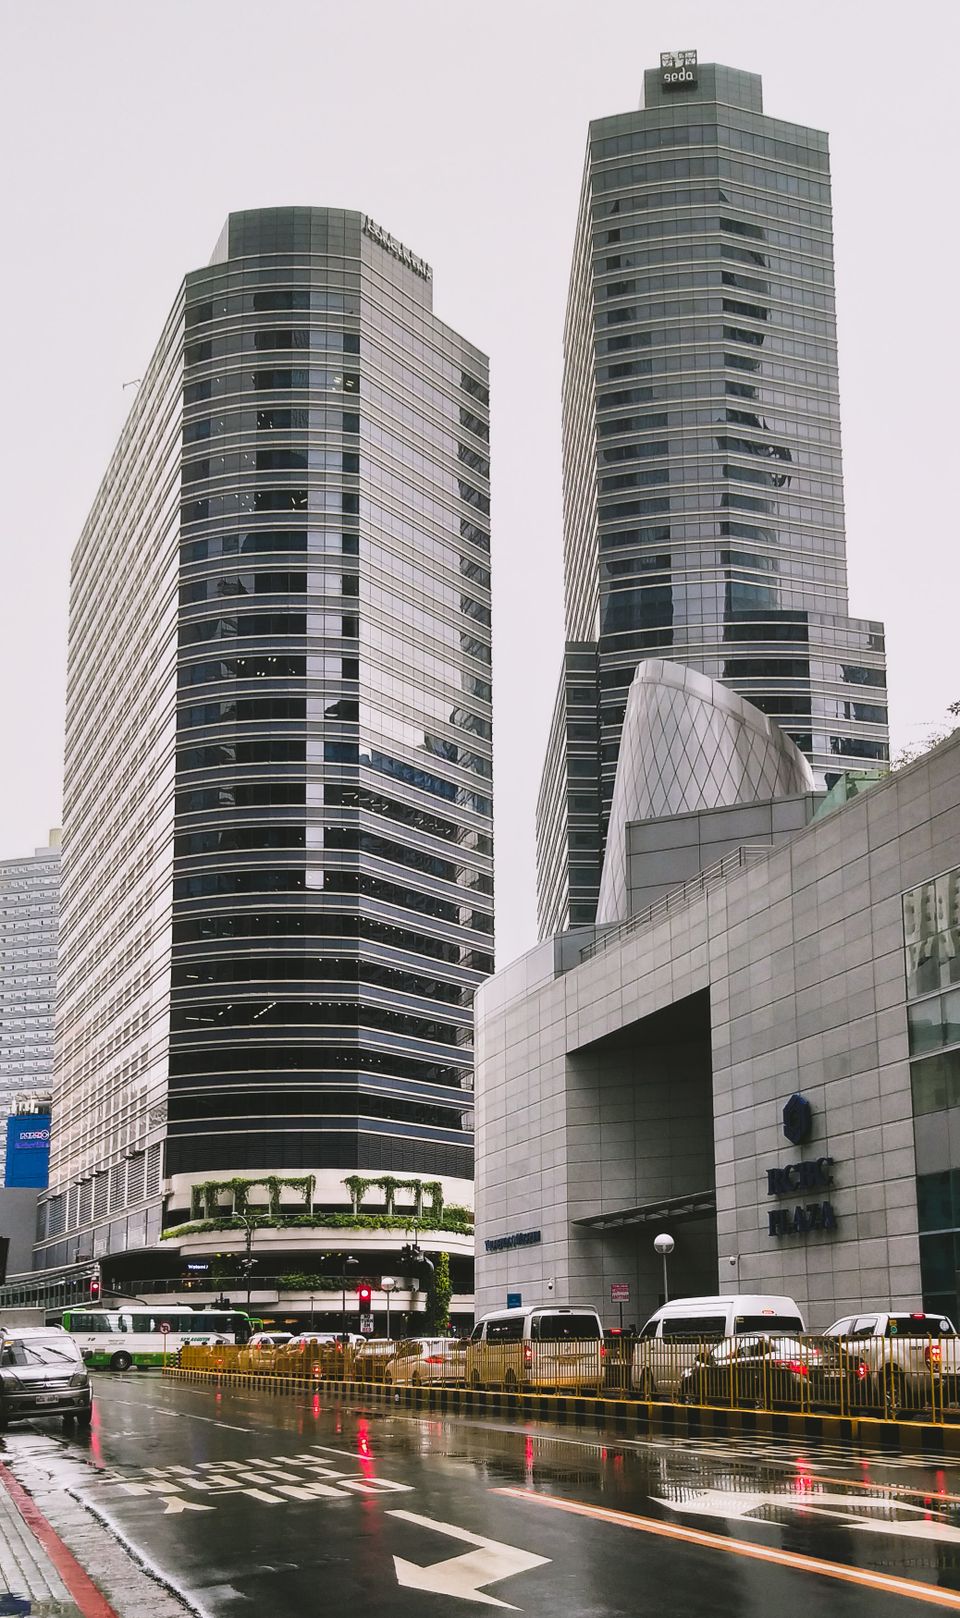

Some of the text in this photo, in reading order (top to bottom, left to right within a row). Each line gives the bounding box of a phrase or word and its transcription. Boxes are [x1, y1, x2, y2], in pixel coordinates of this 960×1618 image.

[664, 67, 693, 82] seda
[768, 1200, 837, 1237] PLAZA
[97, 1454, 336, 1484] RIGHT
[118, 1466, 365, 1496] TURN
[158, 1478, 416, 1515] ONLY
